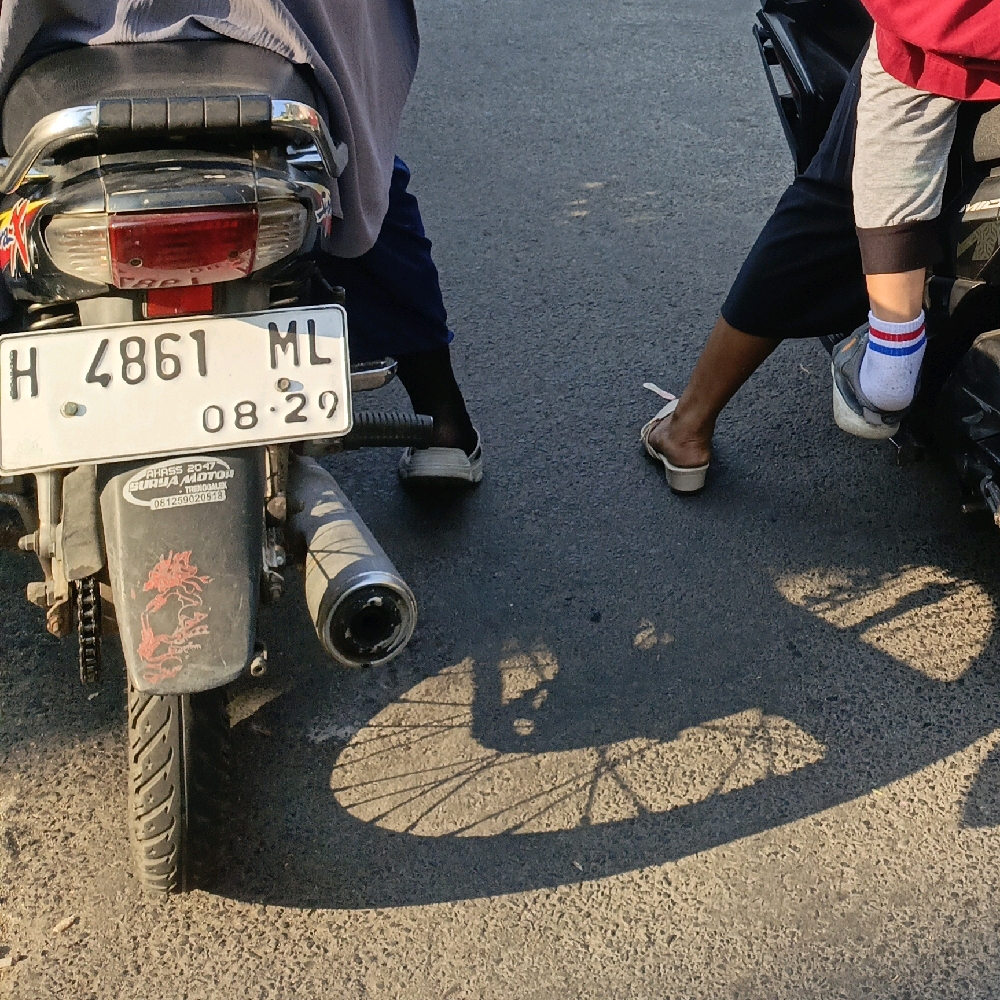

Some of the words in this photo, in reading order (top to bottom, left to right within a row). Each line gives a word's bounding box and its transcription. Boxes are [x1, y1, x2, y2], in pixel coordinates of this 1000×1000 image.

[9, 346, 39, 400] H
[85, 328, 208, 388] 4861
[267, 318, 332, 369] ML
